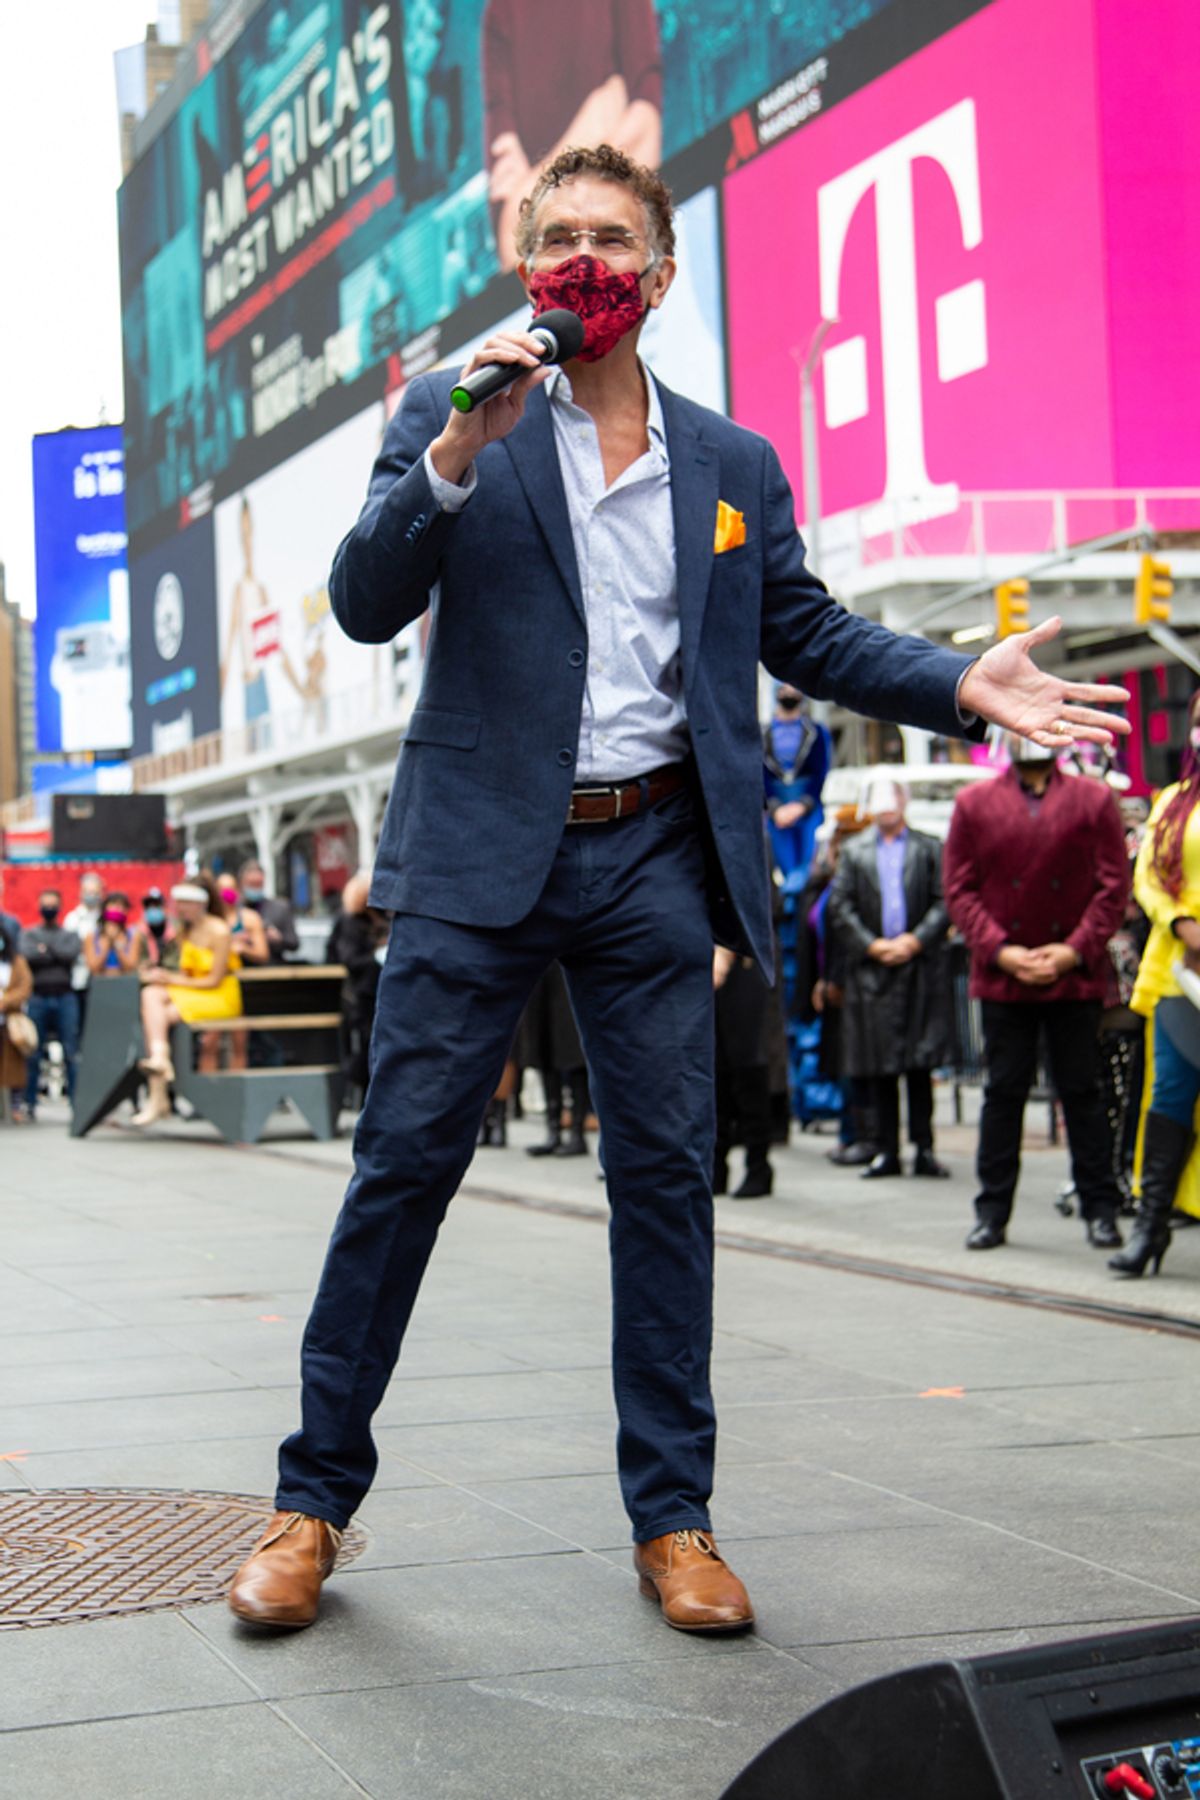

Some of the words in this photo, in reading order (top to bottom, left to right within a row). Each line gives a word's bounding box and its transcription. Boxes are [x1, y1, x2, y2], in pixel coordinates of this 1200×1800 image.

[203, 3, 391, 257] AMERICA'S
[204, 215, 270, 319] MOST
[272, 98, 395, 254] WANTED
